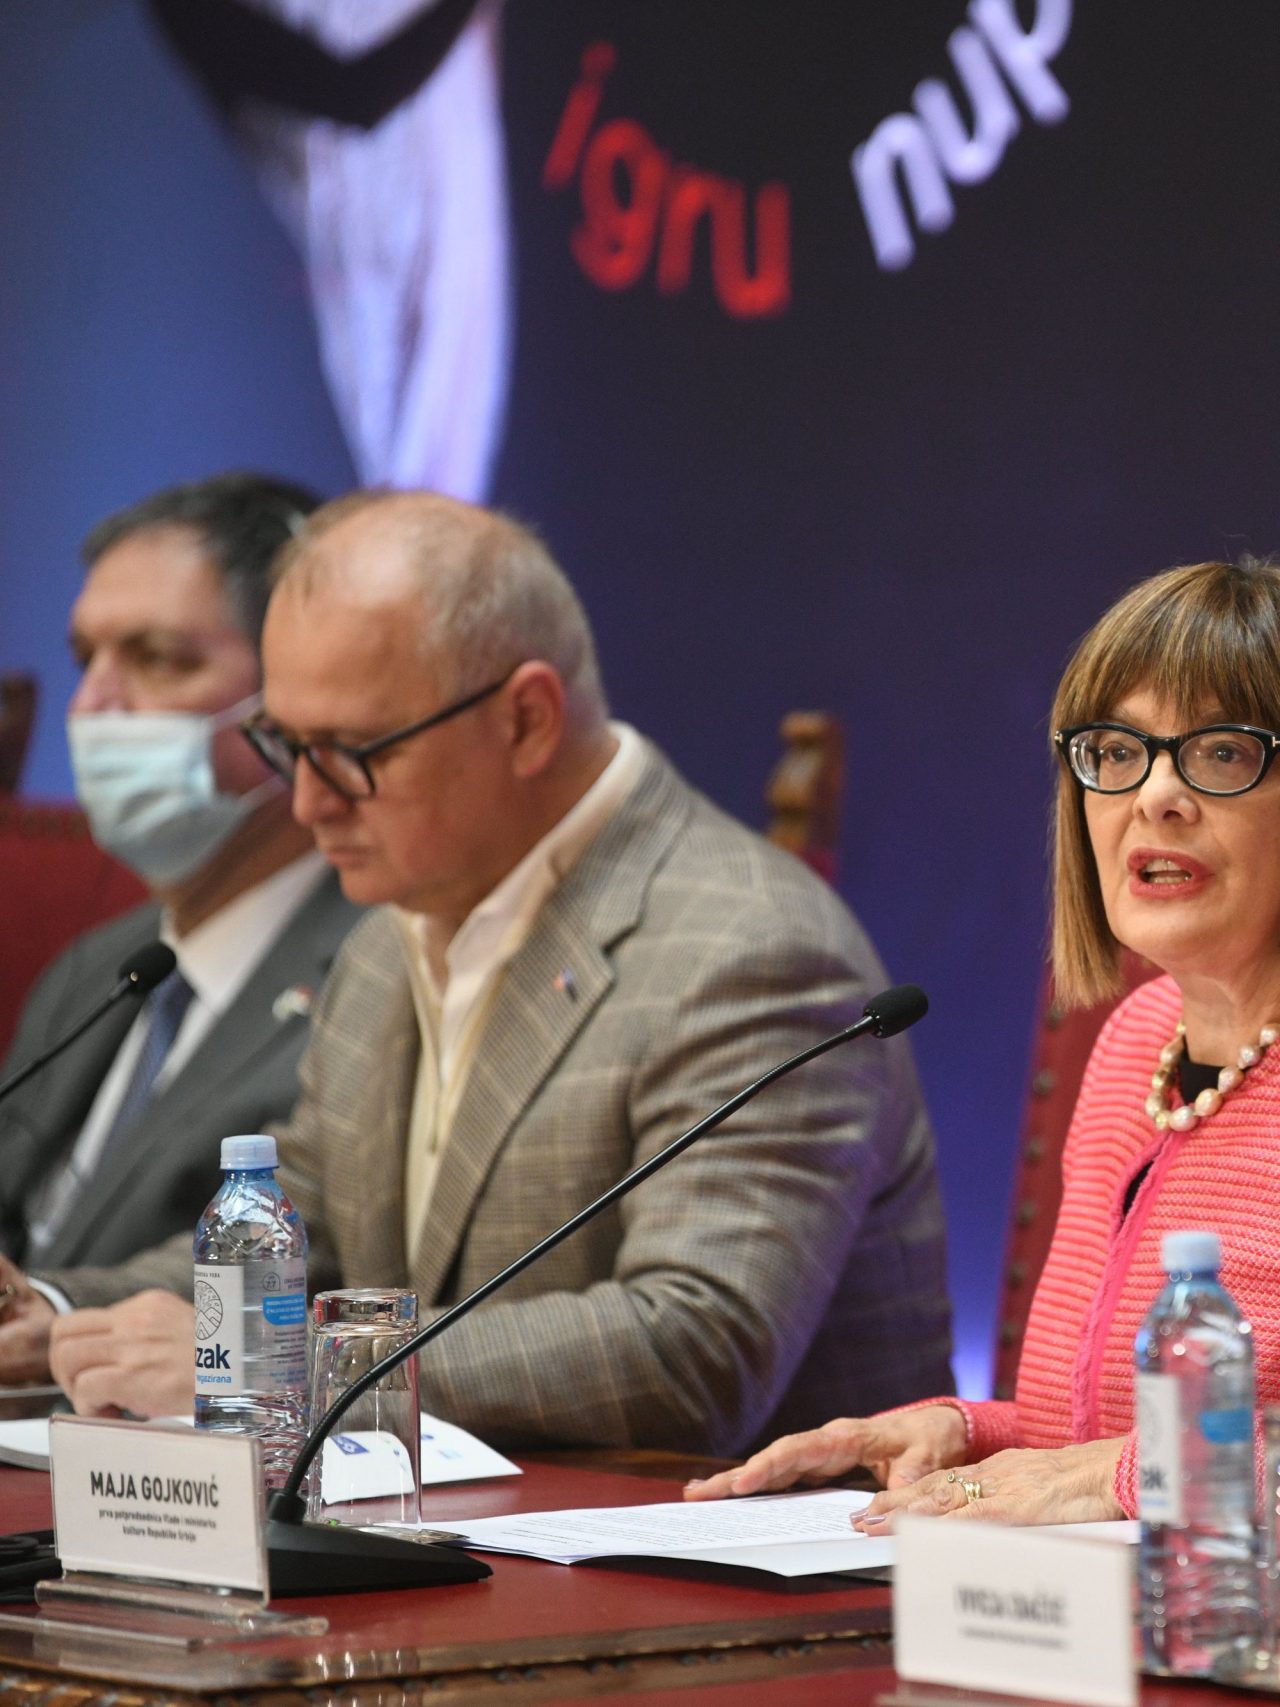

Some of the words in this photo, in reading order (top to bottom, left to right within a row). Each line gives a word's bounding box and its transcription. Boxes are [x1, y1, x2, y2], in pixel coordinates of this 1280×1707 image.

[541, 40, 792, 320] igru
[195, 1343, 231, 1370] zak
[90, 1471, 137, 1499] MAJA
[141, 1474, 219, 1508] GOJKOVIĆ
